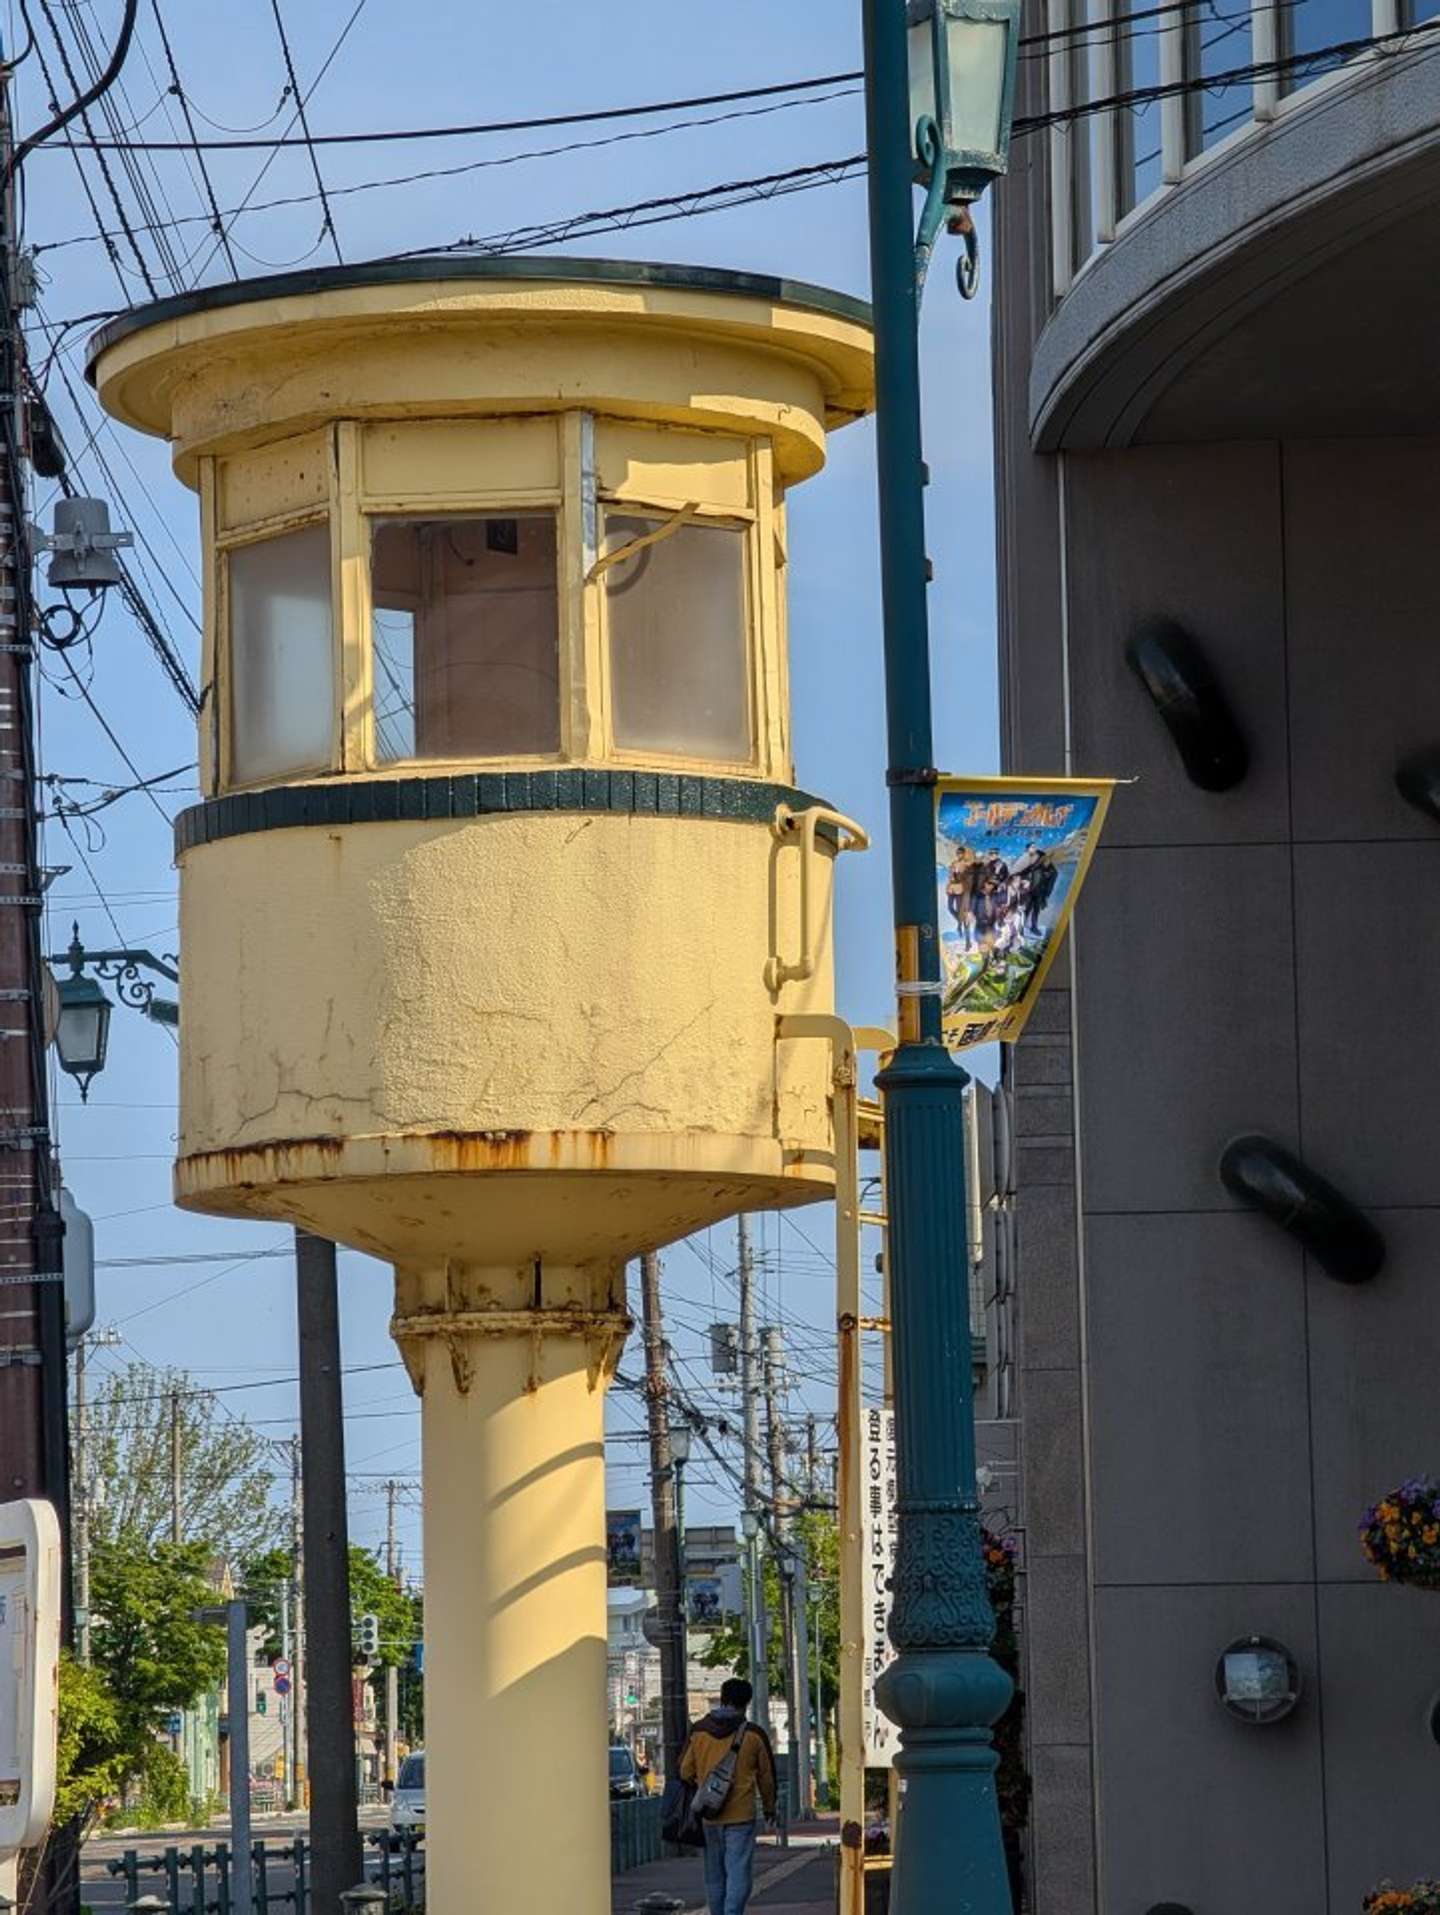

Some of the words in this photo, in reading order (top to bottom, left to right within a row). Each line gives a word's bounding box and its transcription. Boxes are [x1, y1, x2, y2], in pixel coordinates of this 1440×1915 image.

[868, 1409, 889, 1749] 登る事はできまん
